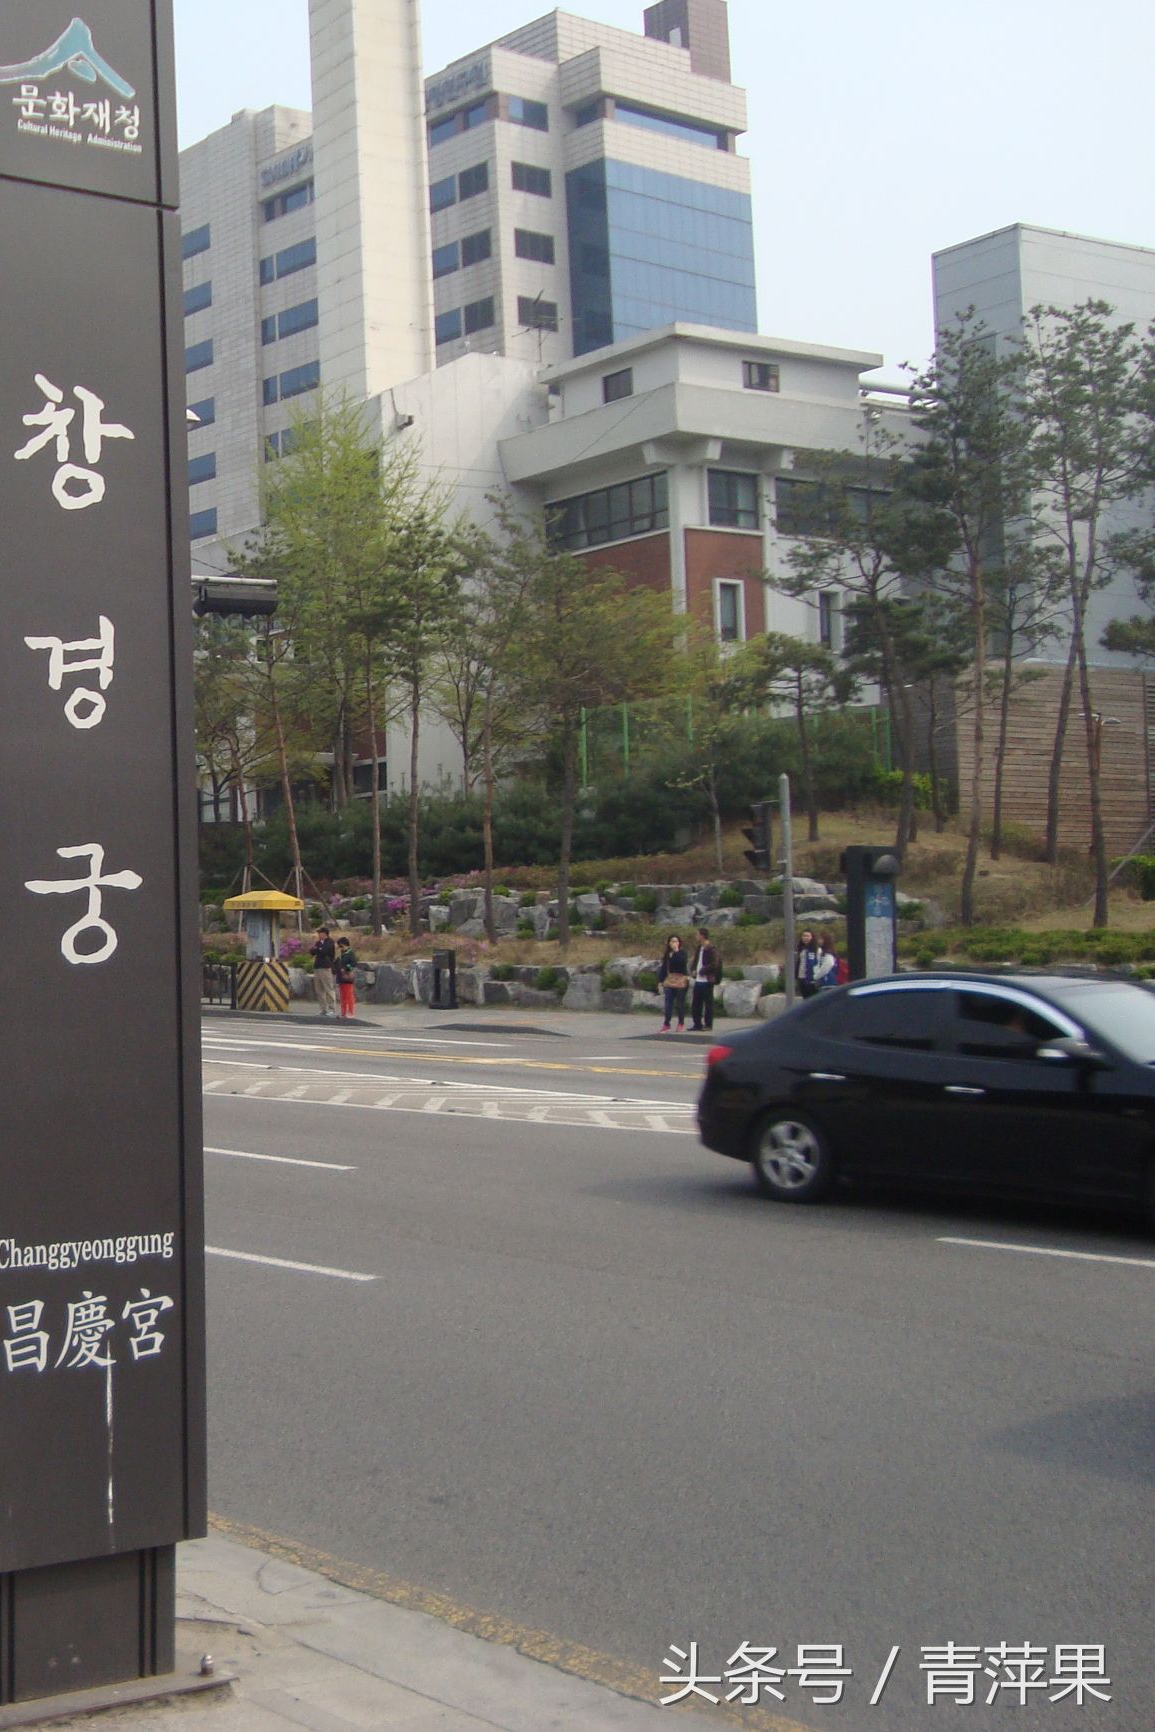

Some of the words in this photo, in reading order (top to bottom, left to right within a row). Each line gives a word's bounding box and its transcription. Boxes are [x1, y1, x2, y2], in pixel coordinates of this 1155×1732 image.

[12, 84, 140, 140] 문화재청
[17, 119, 48, 135] Cultural
[49, 125, 82, 144] Heritage
[87, 133, 142, 153] Administration
[14, 373, 143, 965] 창경궁
[2, 1288, 174, 1373] 昌慶宮
